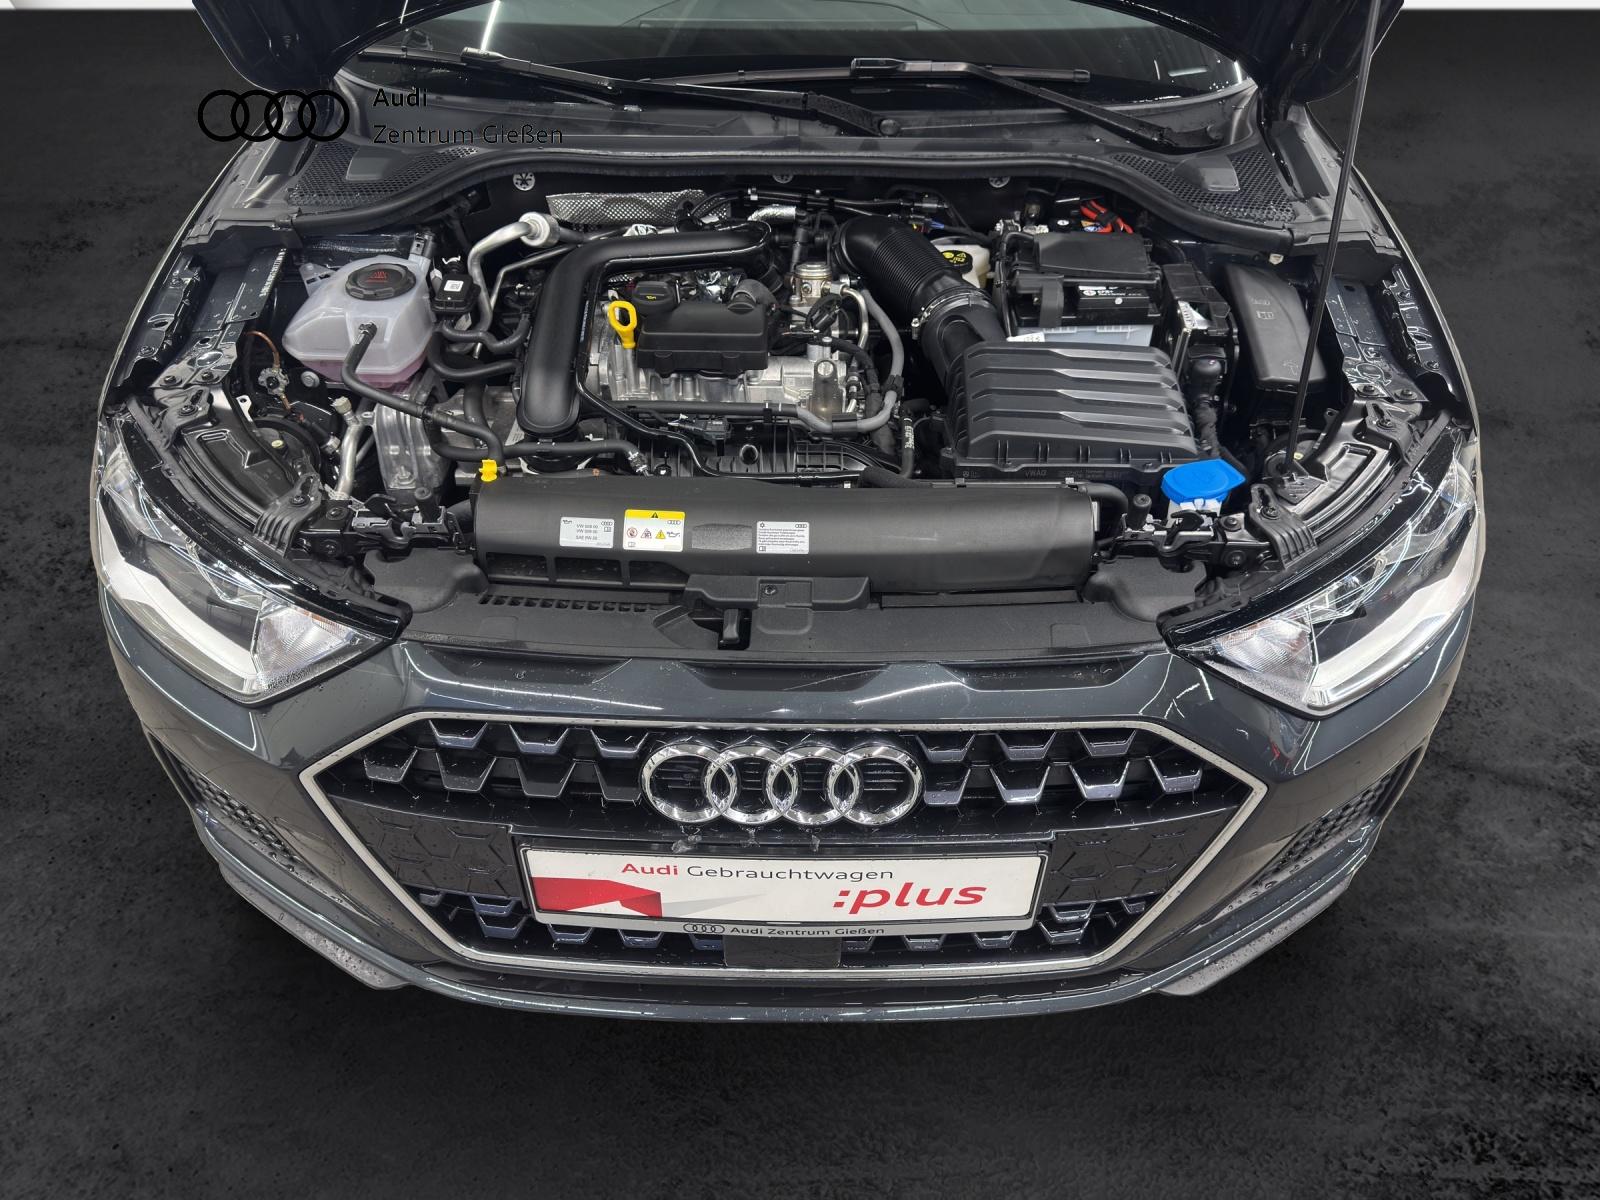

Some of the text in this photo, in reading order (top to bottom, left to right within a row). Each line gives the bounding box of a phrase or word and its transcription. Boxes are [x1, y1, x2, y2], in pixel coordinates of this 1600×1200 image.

[621, 863, 894, 882] Audi Gebrauchtwagen
[730, 927, 885, 936] Audi Zentrum Gießen
